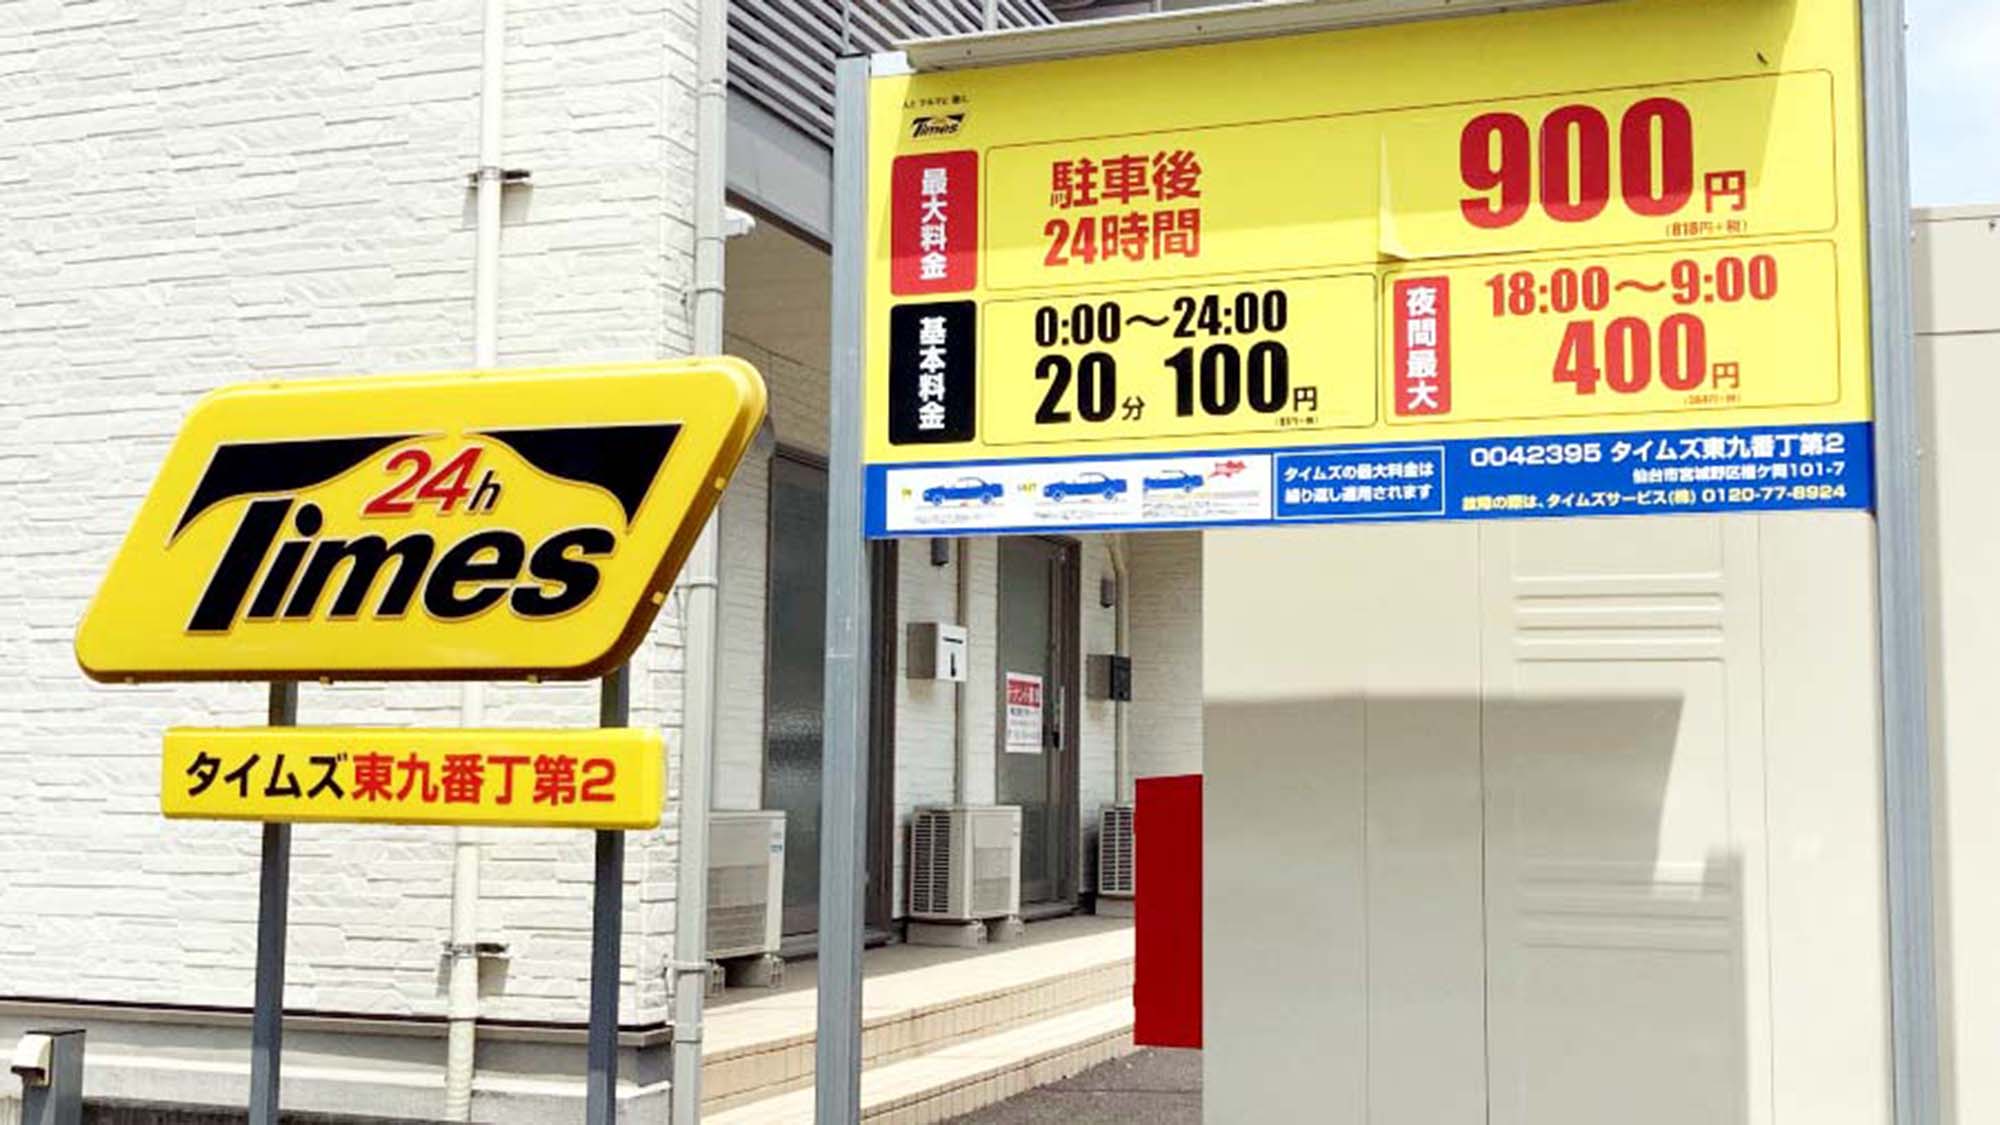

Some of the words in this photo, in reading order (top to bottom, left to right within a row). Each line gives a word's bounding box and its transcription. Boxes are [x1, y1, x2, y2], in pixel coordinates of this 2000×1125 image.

[1050, 149, 1202, 210] 駐車後
[1459, 96, 1747, 229] 900円
[919, 167, 948, 282] 最大料金
[1043, 208, 1202, 267] 24時間
[918, 316, 947, 431] 基本料金
[1034, 350, 1146, 425] 20分
[1164, 339, 1318, 418] 100円
[1405, 286, 1438, 411] 夜間最大
[1552, 312, 1741, 396] 400円
[360, 446, 506, 518] 24h
[1284, 462, 1435, 482] タイムズの最大料金は
[1470, 443, 1602, 467] 0042395
[1611, 432, 1846, 462] タイムズ東九番丁第2
[1701, 484, 1847, 503] 0120-77-8924
[172, 432, 622, 634] Times
[185, 750, 616, 807] タイムズ東九番丁第2
